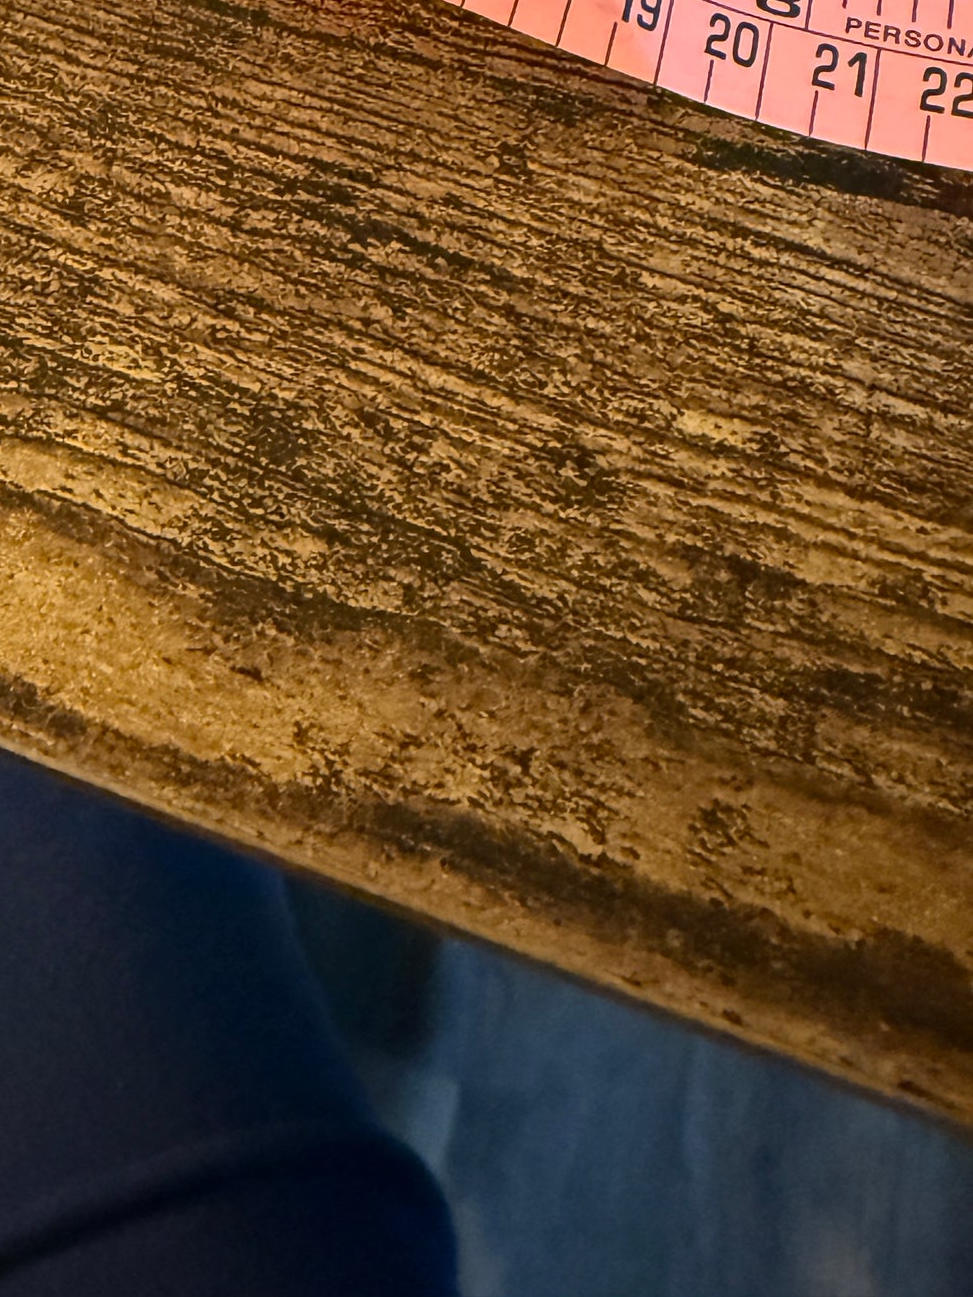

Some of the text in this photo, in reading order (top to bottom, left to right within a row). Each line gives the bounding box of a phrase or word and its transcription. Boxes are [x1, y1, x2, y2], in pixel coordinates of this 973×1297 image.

[704, 13, 759, 67] 20
[812, 43, 868, 97] 21
[920, 67, 973, 119] 22
